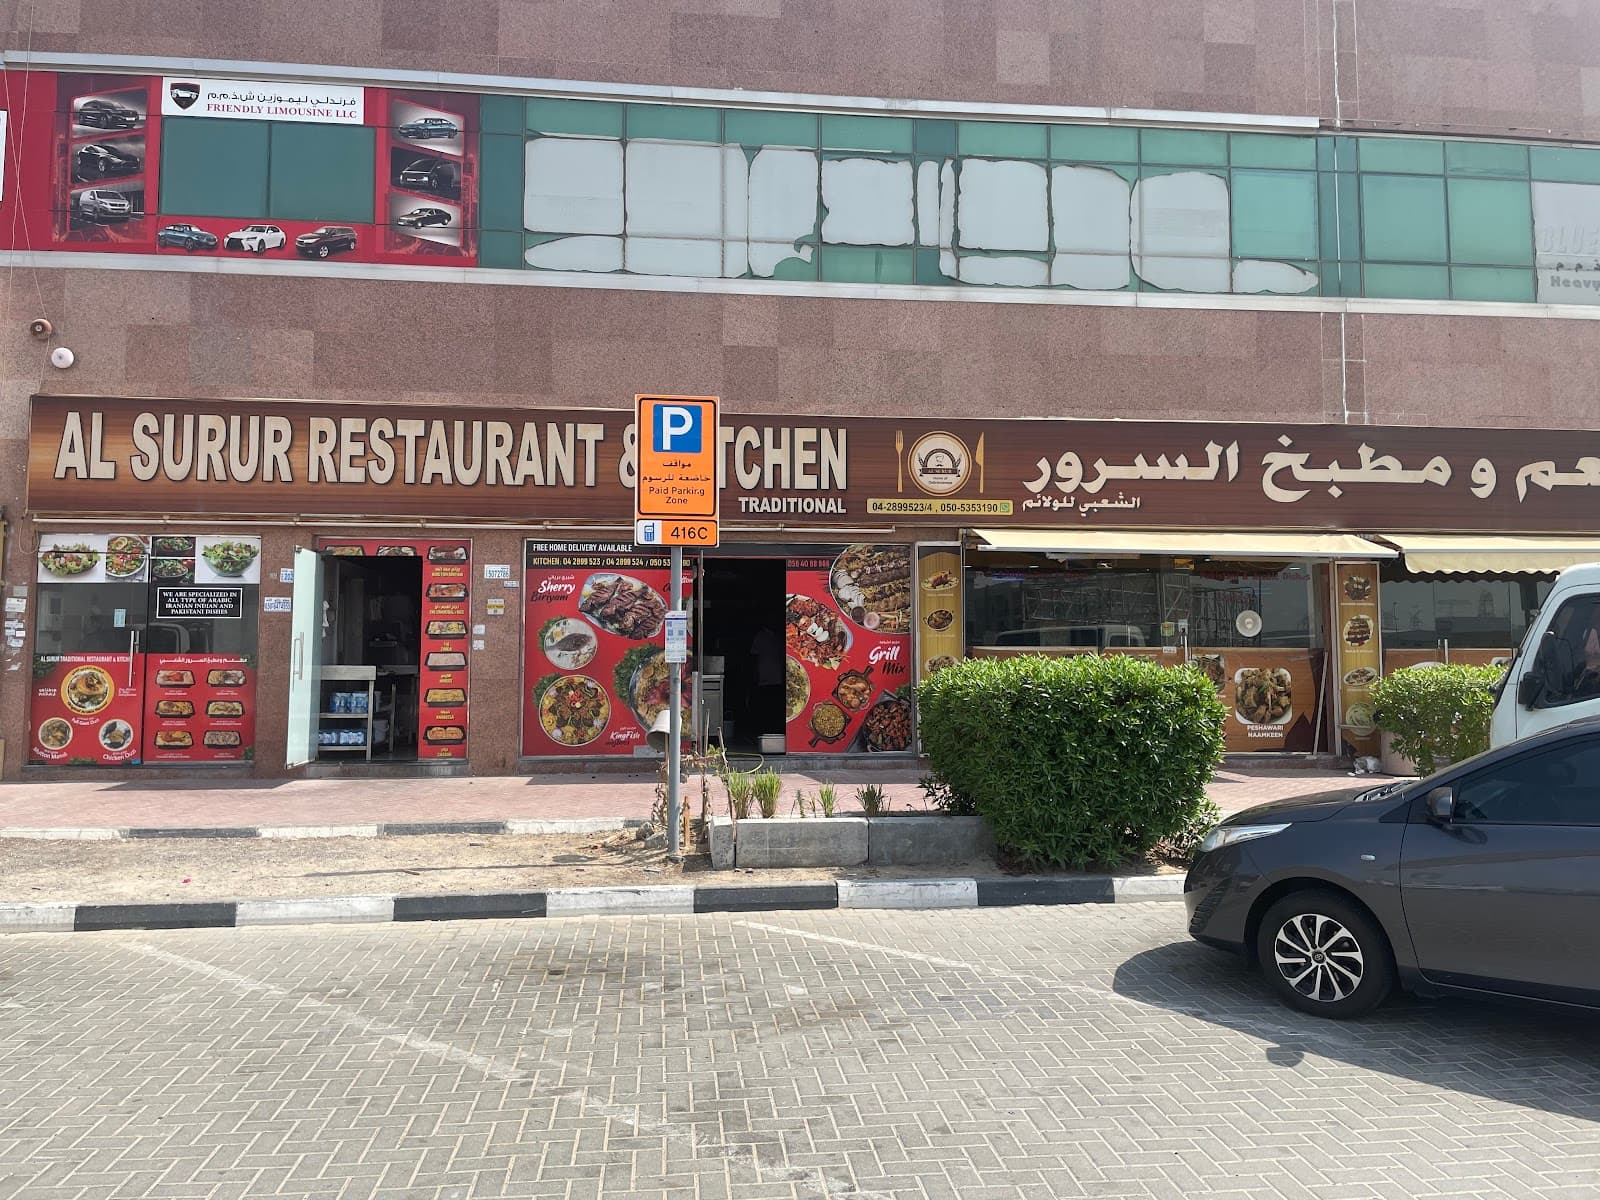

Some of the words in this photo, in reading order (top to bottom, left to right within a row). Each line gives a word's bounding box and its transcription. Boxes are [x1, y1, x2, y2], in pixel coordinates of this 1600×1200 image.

[257, 92, 308, 105] ليموزين
[311, 95, 357, 108] فرندلي
[206, 103, 266, 114] FRIENDLY
[266, 105, 333, 118] LIMOUSINE
[335, 109, 358, 119] LLC
[661, 406, 694, 451] P
[54, 410, 117, 480] AL
[129, 411, 294, 483] SURUR
[307, 416, 604, 487] RESTAURANT
[719, 425, 848, 491] TCHEN
[662, 459, 692, 469] مواقف
[1021, 438, 1239, 494] السرور
[1261, 433, 1452, 503] مطبخ
[649, 486, 669, 495] Paid
[665, 496, 688, 504] Zone
[738, 496, 847, 514] TRADITIONAL
[1021, 493, 1075, 512] للولائم
[1079, 491, 1141, 517] الشعبي
[872, 502, 932, 512] 04-2899523/4
[940, 502, 998, 513] 050-5353190
[671, 526, 708, 540] 416C
[533, 543, 548, 552] FREE
[549, 543, 567, 552] HOME
[568, 543, 598, 552] DELIVERY
[598, 544, 633, 553] AVAILABLE
[563, 557, 572, 566] 04
[588, 558, 601, 566] 523
[606, 558, 615, 567] 04
[631, 558, 644, 567] 524
[650, 559, 662, 567] 050
[538, 580, 576, 595] Sherry
[869, 646, 900, 665] Grill
[881, 661, 906, 675] Mix
[1246, 724, 1284, 732] PESHAWARI
